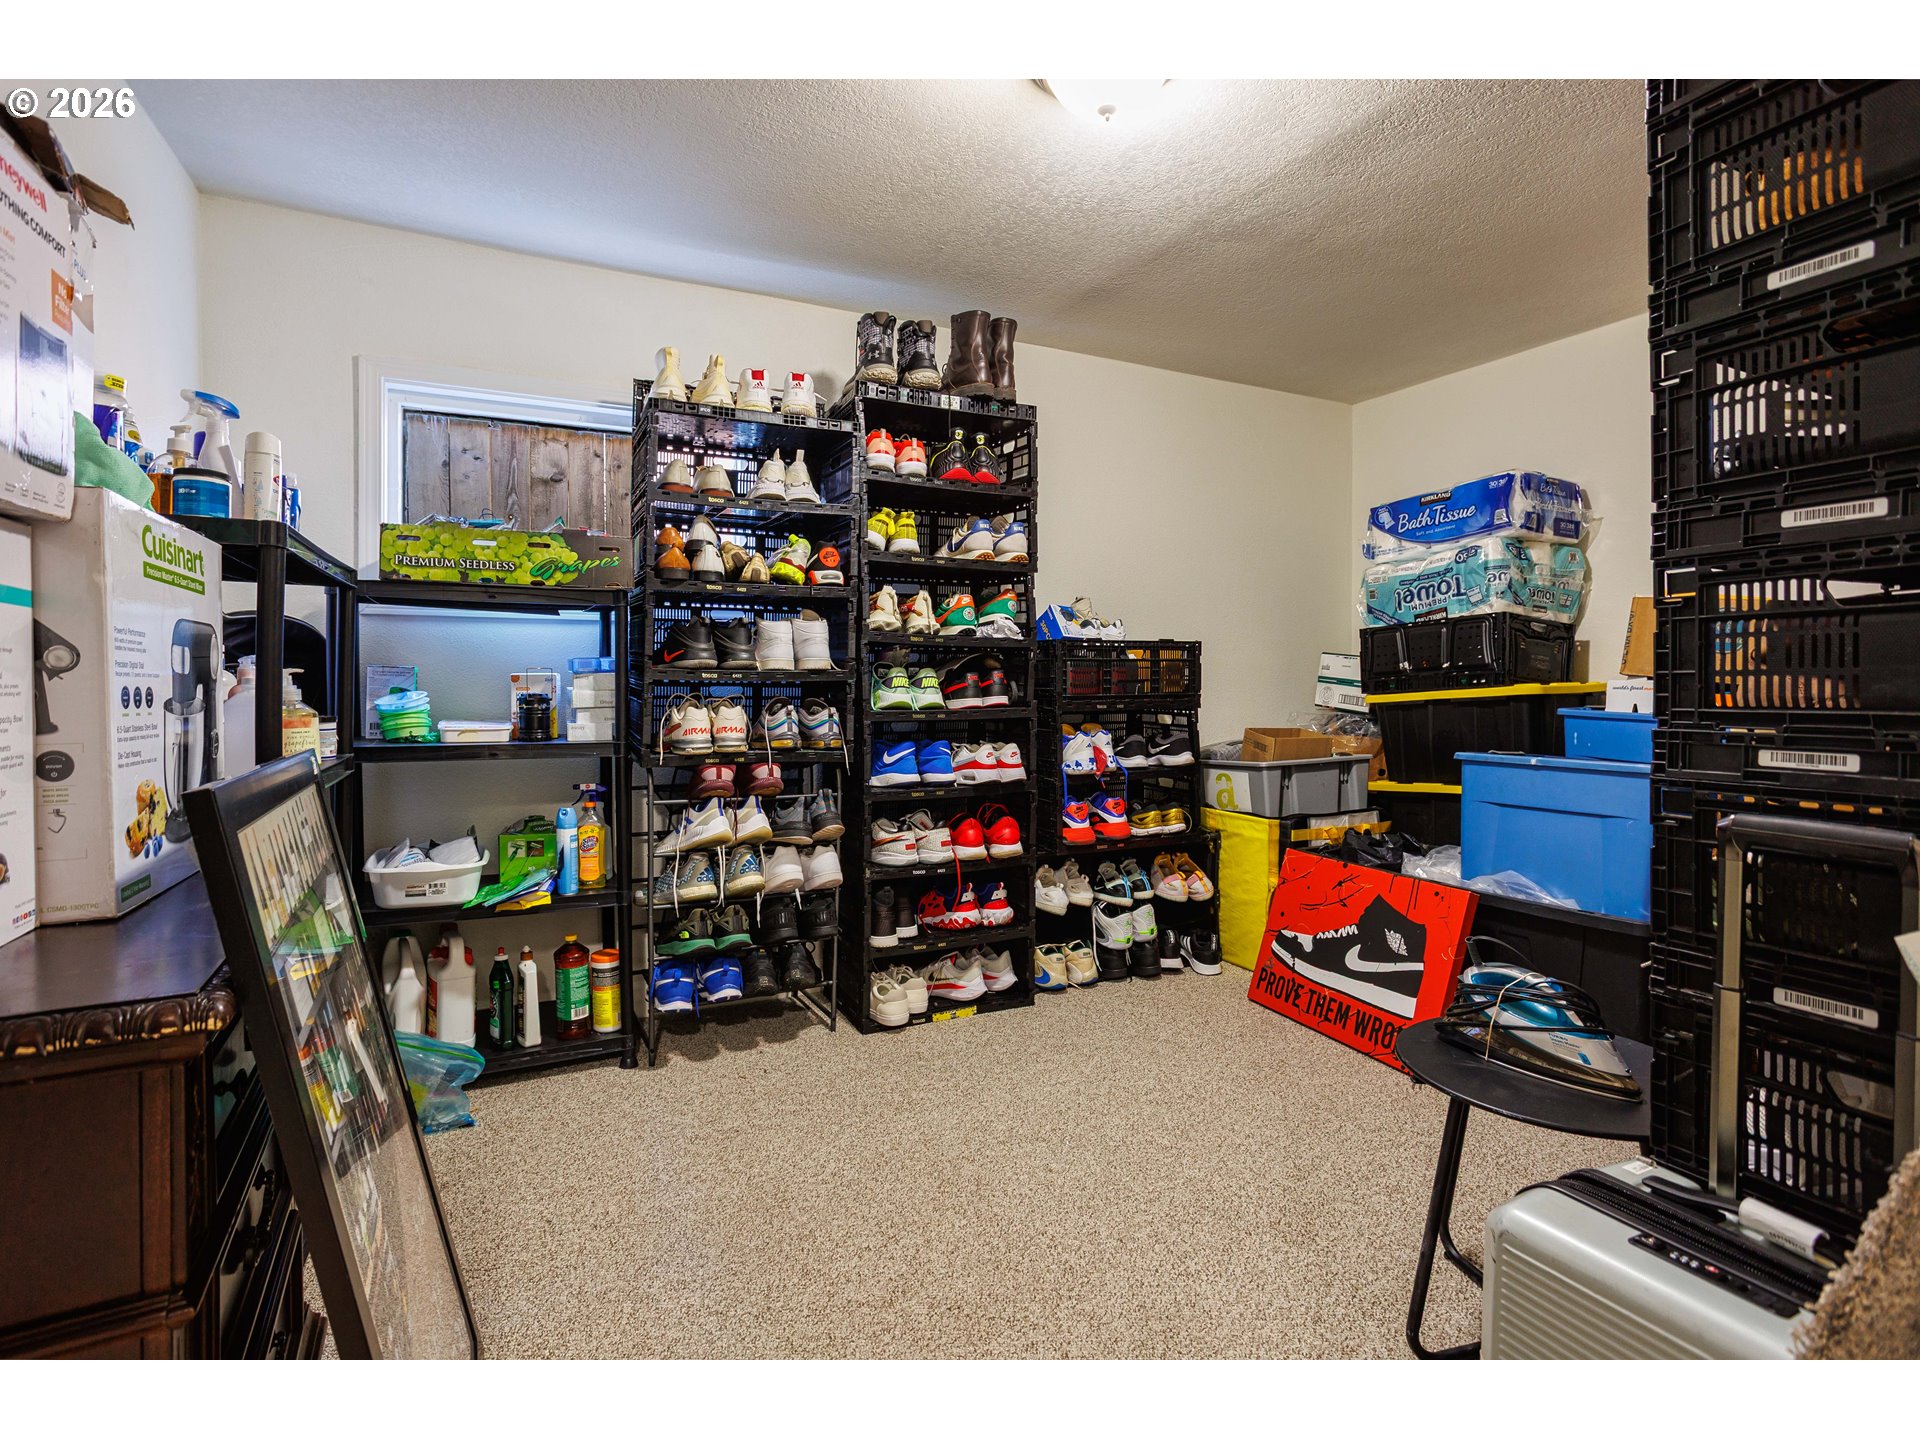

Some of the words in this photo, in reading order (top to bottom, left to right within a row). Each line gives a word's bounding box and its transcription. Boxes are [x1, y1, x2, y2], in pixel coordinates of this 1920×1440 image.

[29, 217, 66, 258] COMFORT
[1420, 492, 1451, 503] KIRKLAND
[1398, 510, 1434, 533] Bath
[1433, 504, 1477, 524] Tissue
[142, 524, 205, 577] Cuisinart
[394, 554, 455, 568] PREMIUM
[458, 558, 515, 571] SEEDLESS
[529, 556, 622, 580] Grapes
[1394, 573, 1466, 614] Towel
[1408, 597, 1449, 613] PREMIUM
[891, 676, 910, 688] NIKE
[921, 676, 939, 688] NIKE
[0, 716, 12, 725] pacity
[13, 714, 23, 723] Bowl
[1256, 967, 1305, 1009] PROVE
[1303, 988, 1352, 1030] THEM
[1353, 1007, 1399, 1049] WRO
